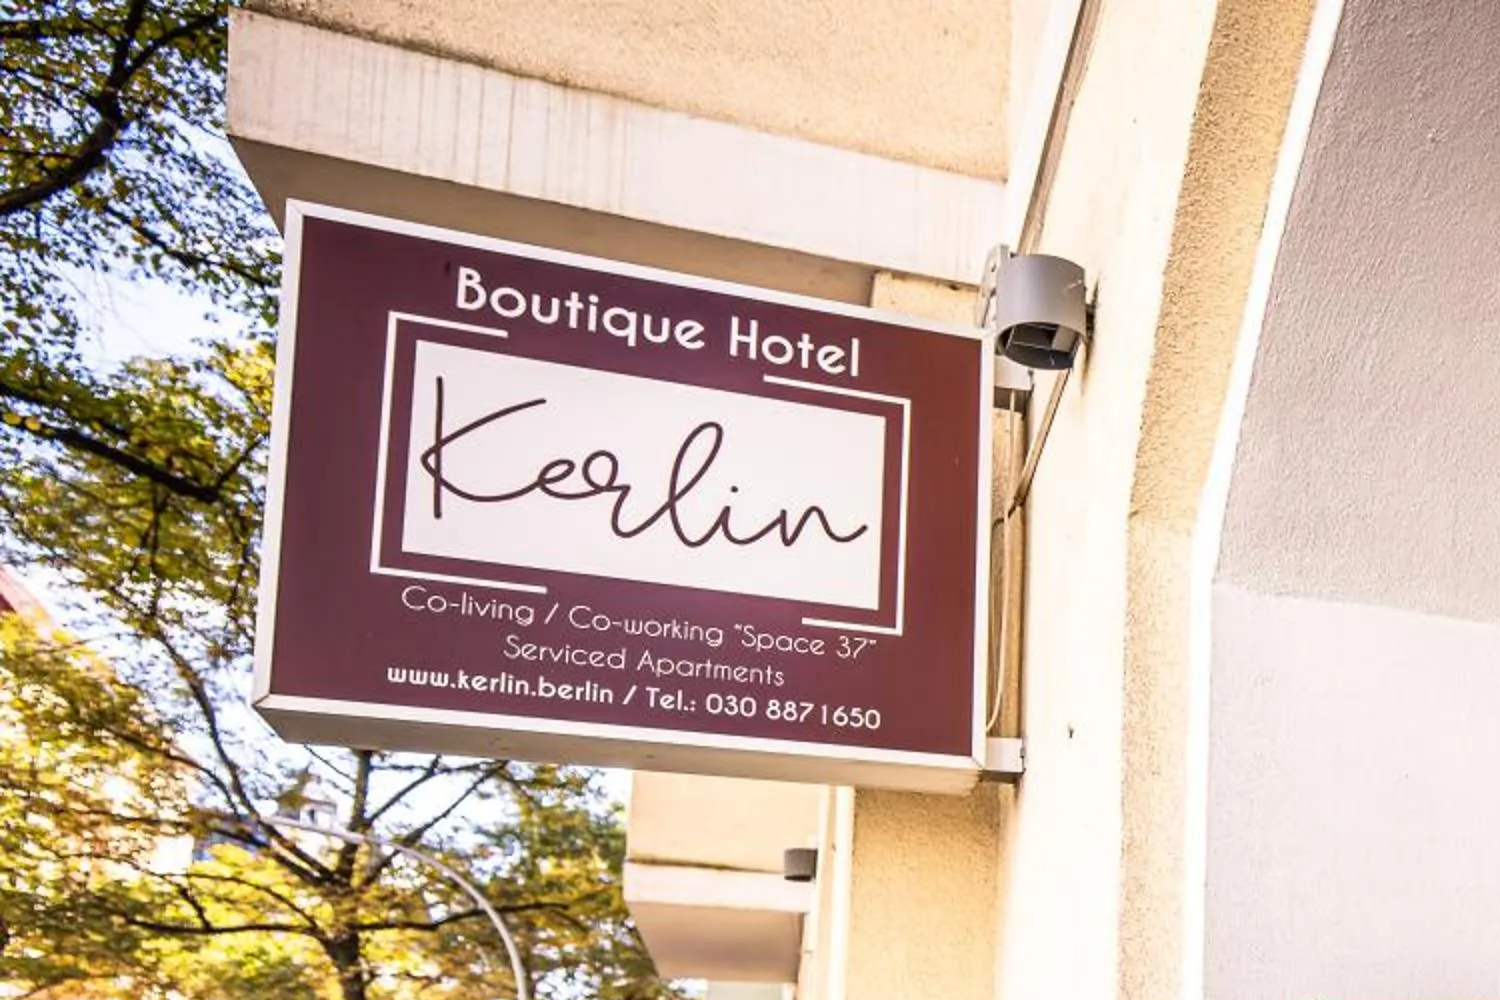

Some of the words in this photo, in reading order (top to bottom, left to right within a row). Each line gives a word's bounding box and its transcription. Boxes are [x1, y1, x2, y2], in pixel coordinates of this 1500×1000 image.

[456, 266, 706, 351] Boutique
[729, 315, 860, 377] Hotel
[419, 375, 868, 549] Kerlin
[401, 585, 535, 626] Co-living
[568, 605, 724, 647] Co-working
[503, 634, 627, 670] Serviced
[636, 650, 786, 687] Apartments
[387, 666, 614, 705] www.kerlin.berlin
[646, 686, 697, 712] Tel.:
[705, 692, 758, 718] 030
